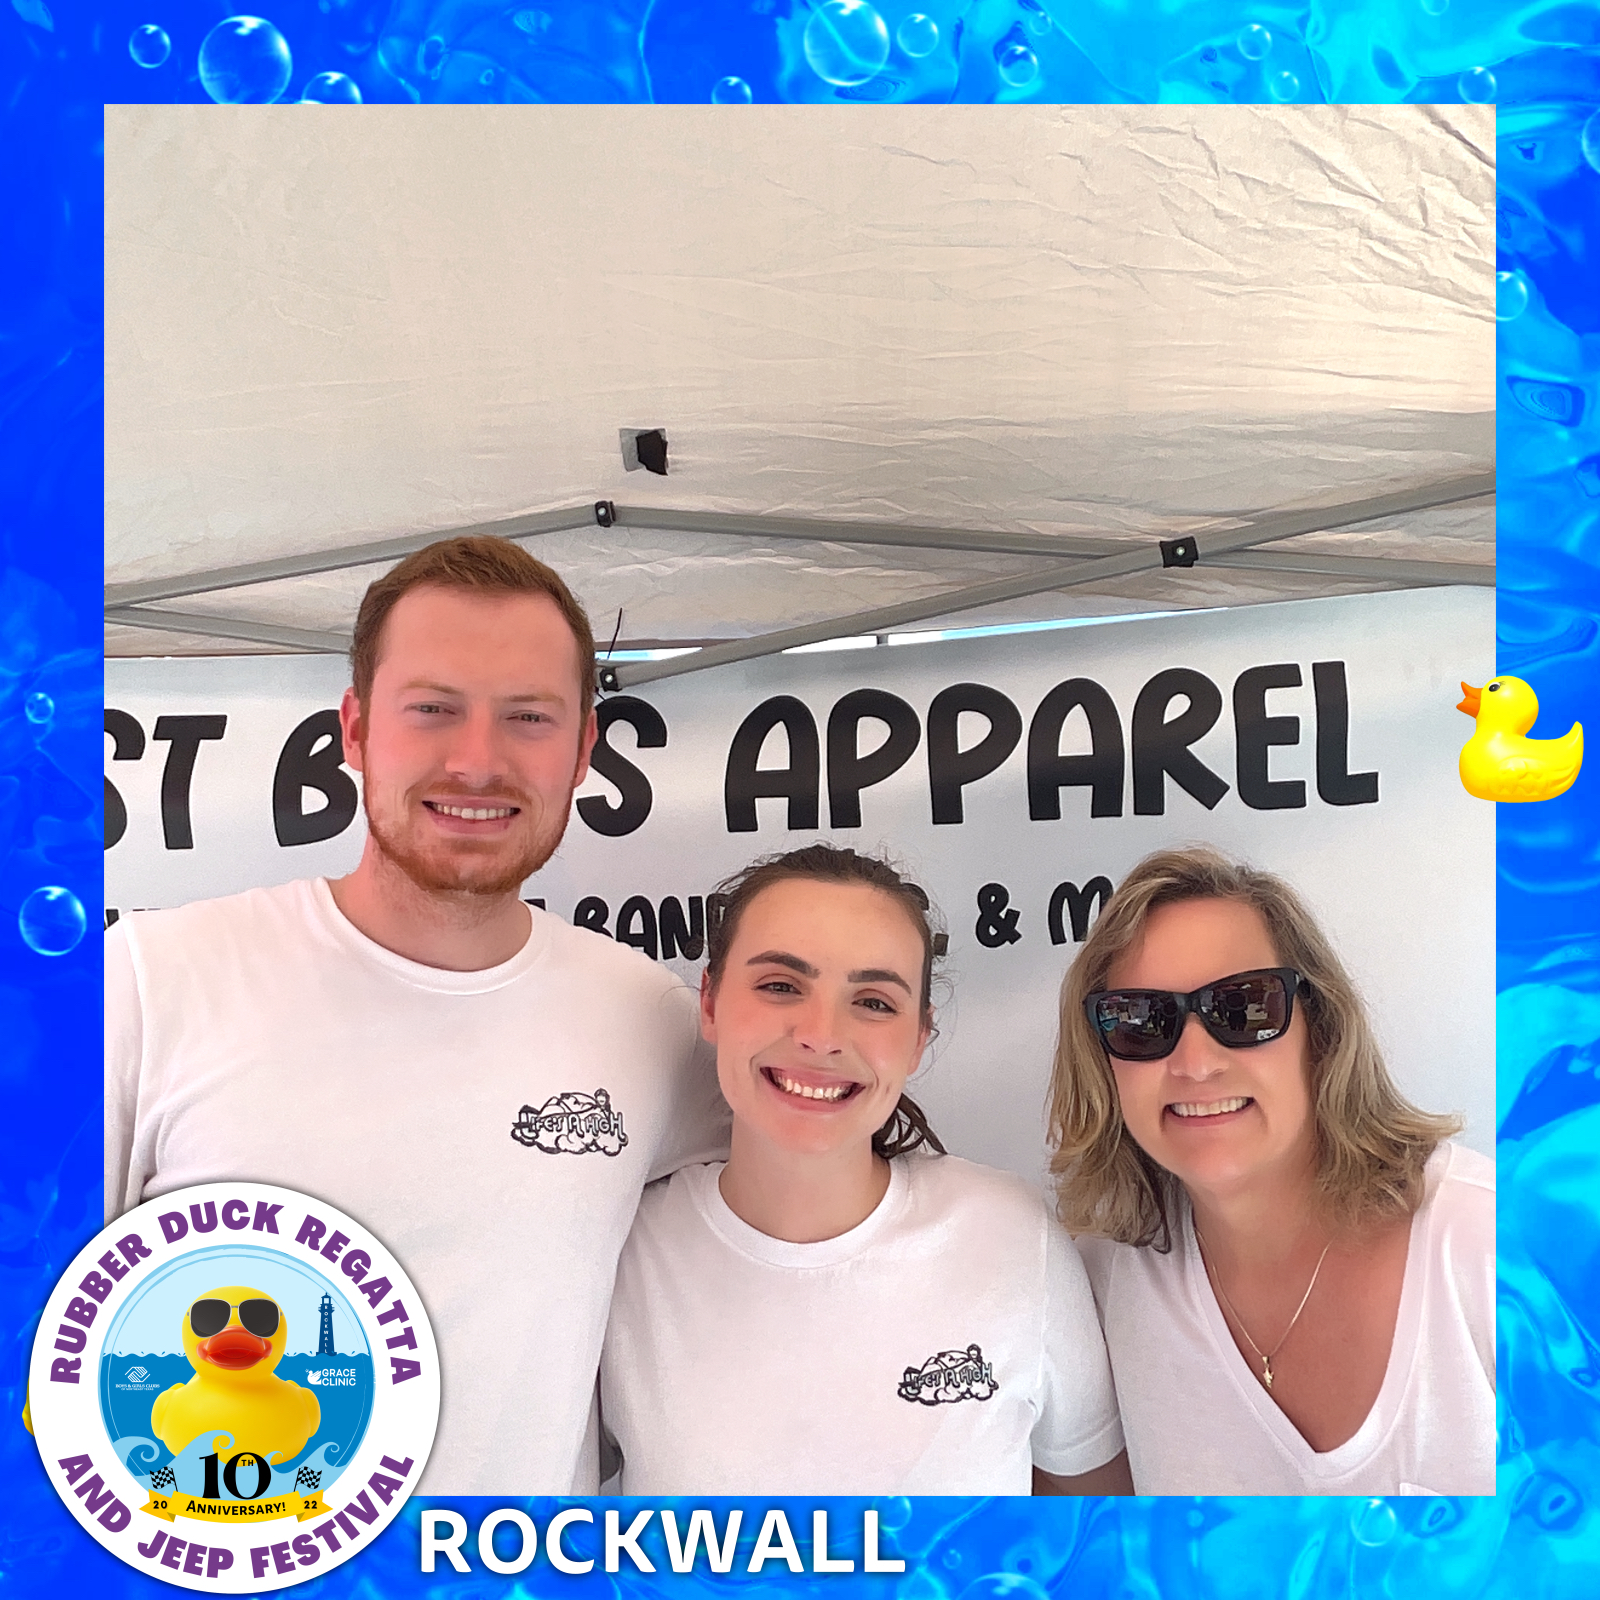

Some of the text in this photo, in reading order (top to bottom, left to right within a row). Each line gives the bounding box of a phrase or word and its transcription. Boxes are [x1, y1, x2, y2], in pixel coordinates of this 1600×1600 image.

[272, 694, 668, 847] BS
[725, 660, 1379, 832] APPAREL
[975, 882, 1022, 948] &
[566, 1112, 585, 1138] A
[584, 1109, 628, 1146] HIGH
[944, 1368, 961, 1388] A
[959, 1361, 999, 1390] HIGH
